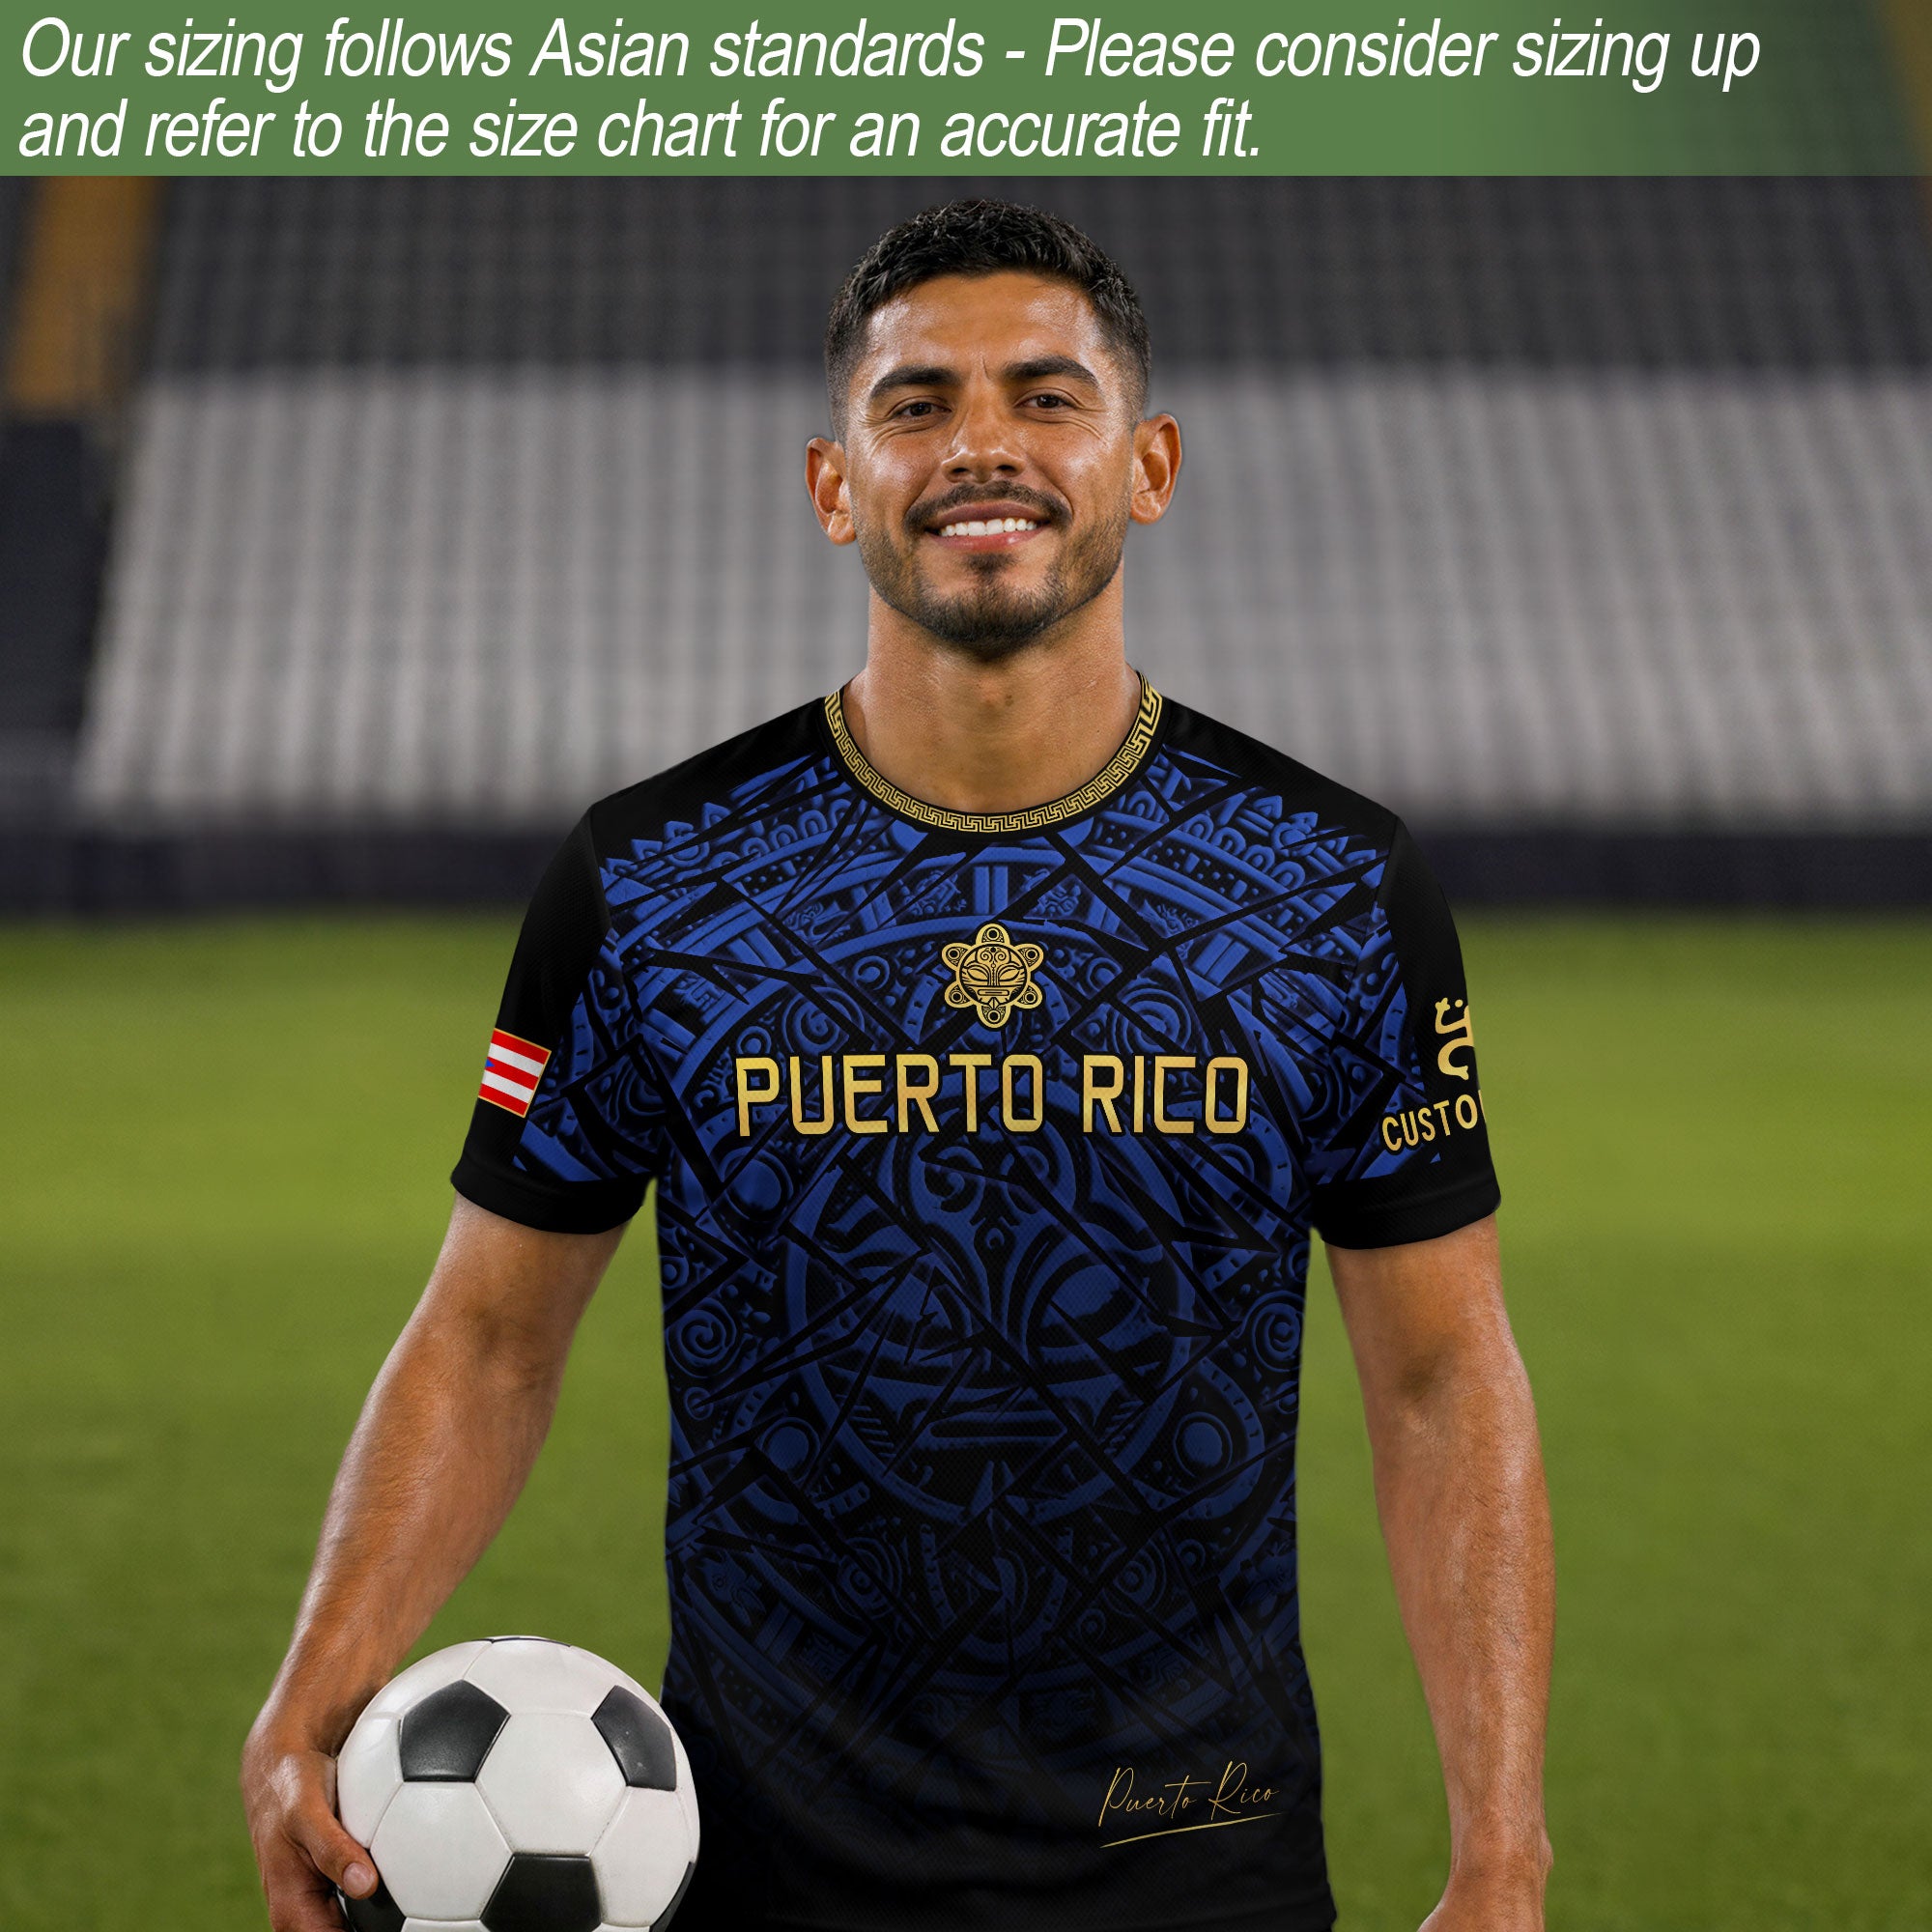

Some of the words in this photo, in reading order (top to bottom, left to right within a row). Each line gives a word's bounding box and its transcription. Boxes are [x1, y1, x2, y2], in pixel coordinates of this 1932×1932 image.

[735, 1053, 1044, 1137] PUERTO
[1082, 1054, 1249, 1134] RICO
[1381, 1090, 1487, 1151] CUSTO
[1097, 1766, 1211, 1828] Puerto
[1208, 1760, 1280, 1821] Rico
